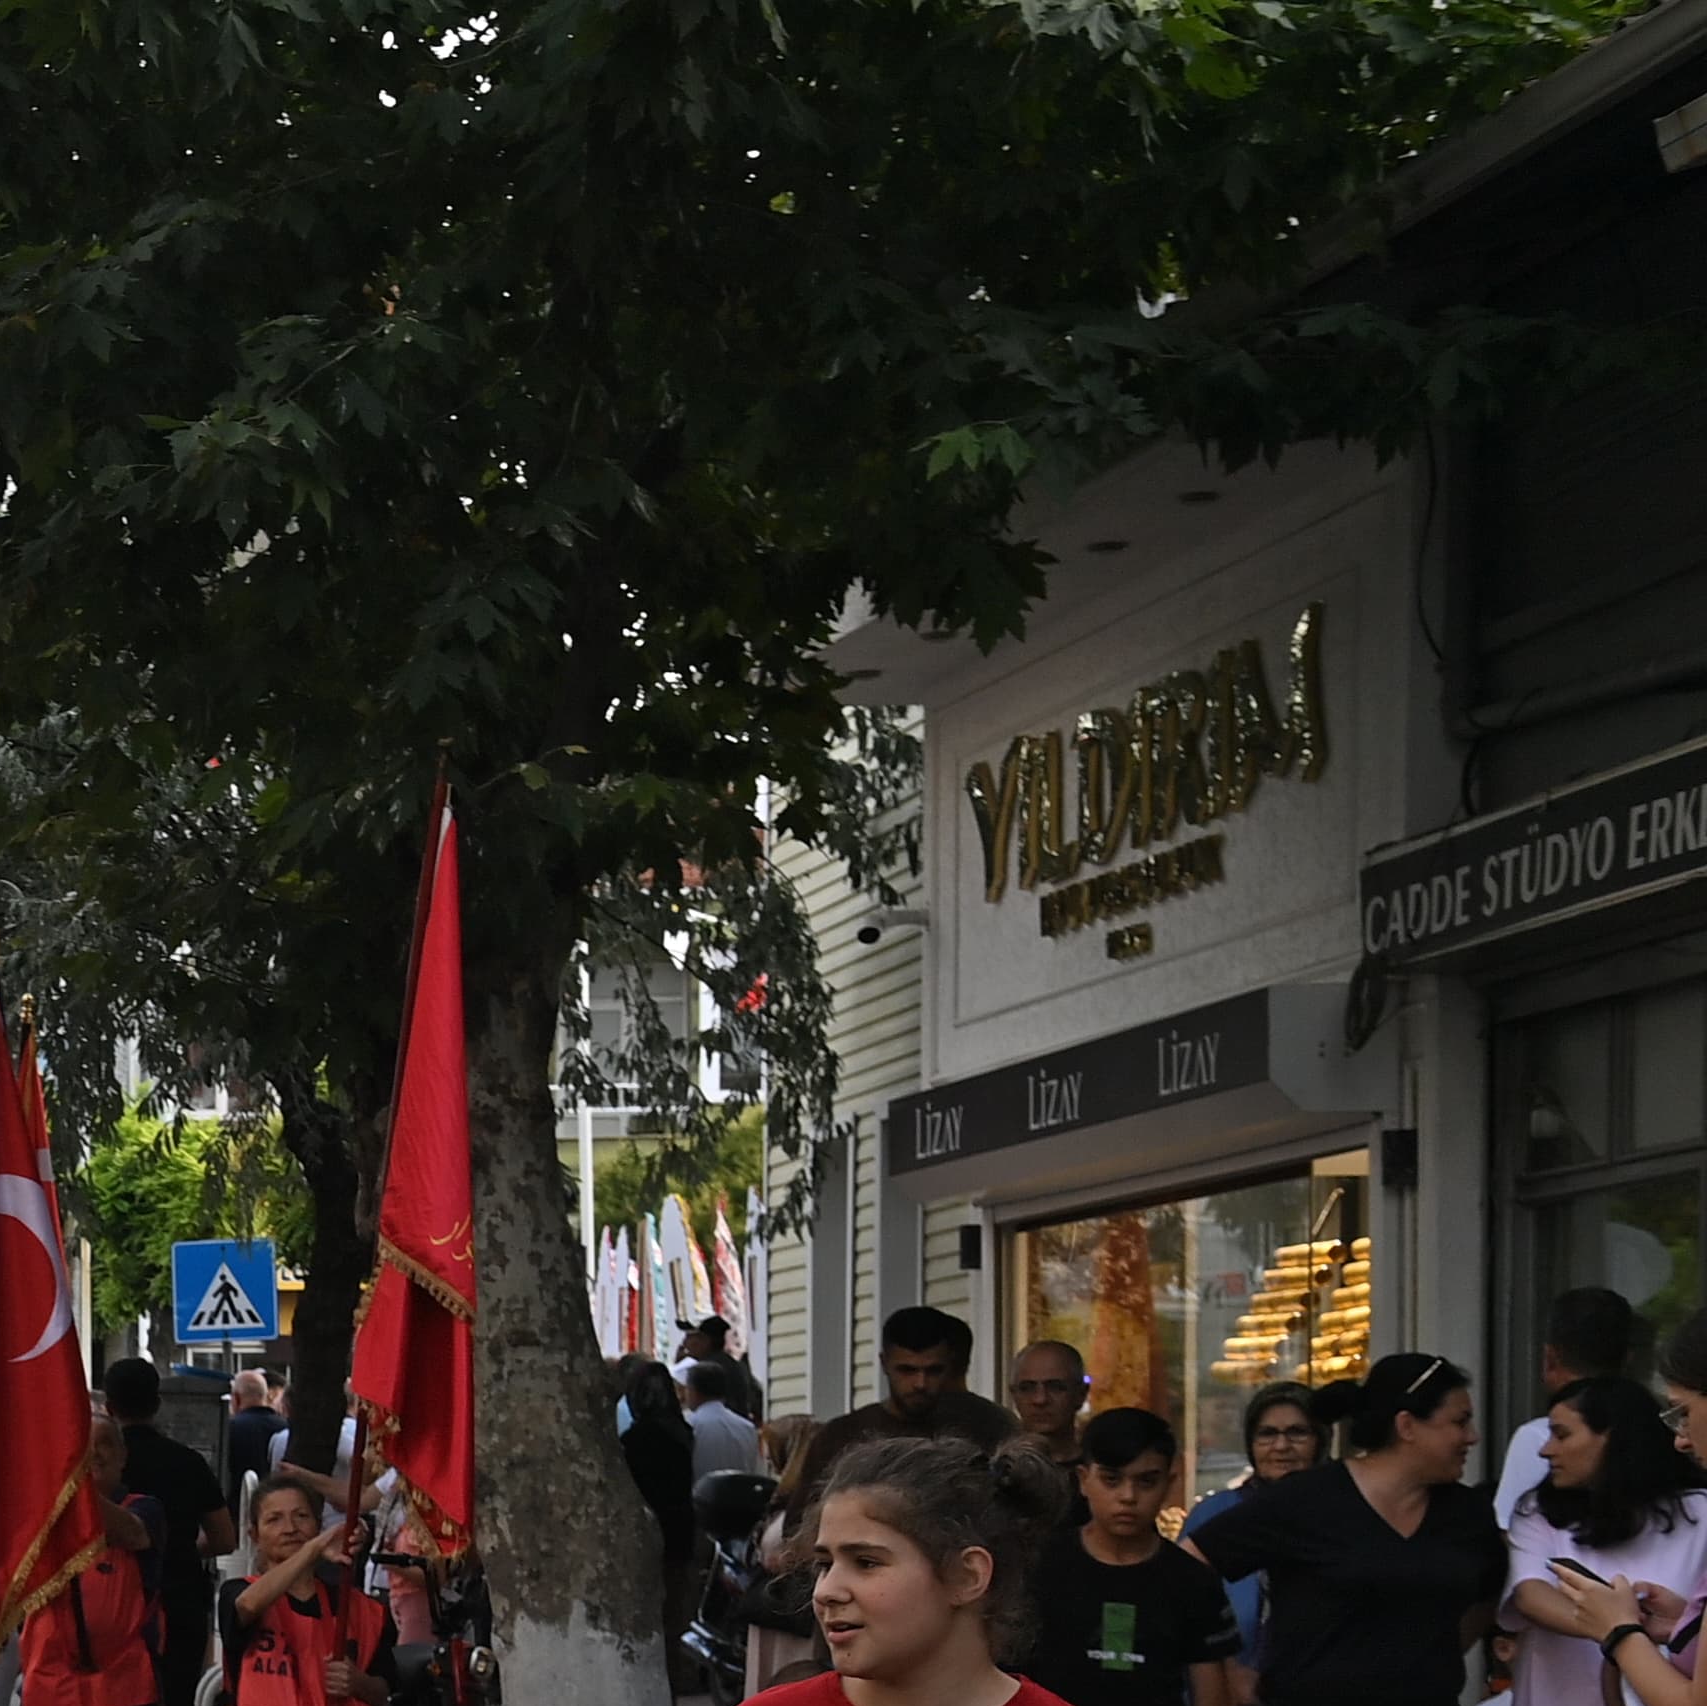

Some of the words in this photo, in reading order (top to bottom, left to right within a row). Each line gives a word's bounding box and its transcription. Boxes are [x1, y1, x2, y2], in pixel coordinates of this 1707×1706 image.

[1364, 864, 1472, 955] CADDE
[1482, 816, 1615, 917] STÜDYO
[252, 1656, 289, 1677] ALA
